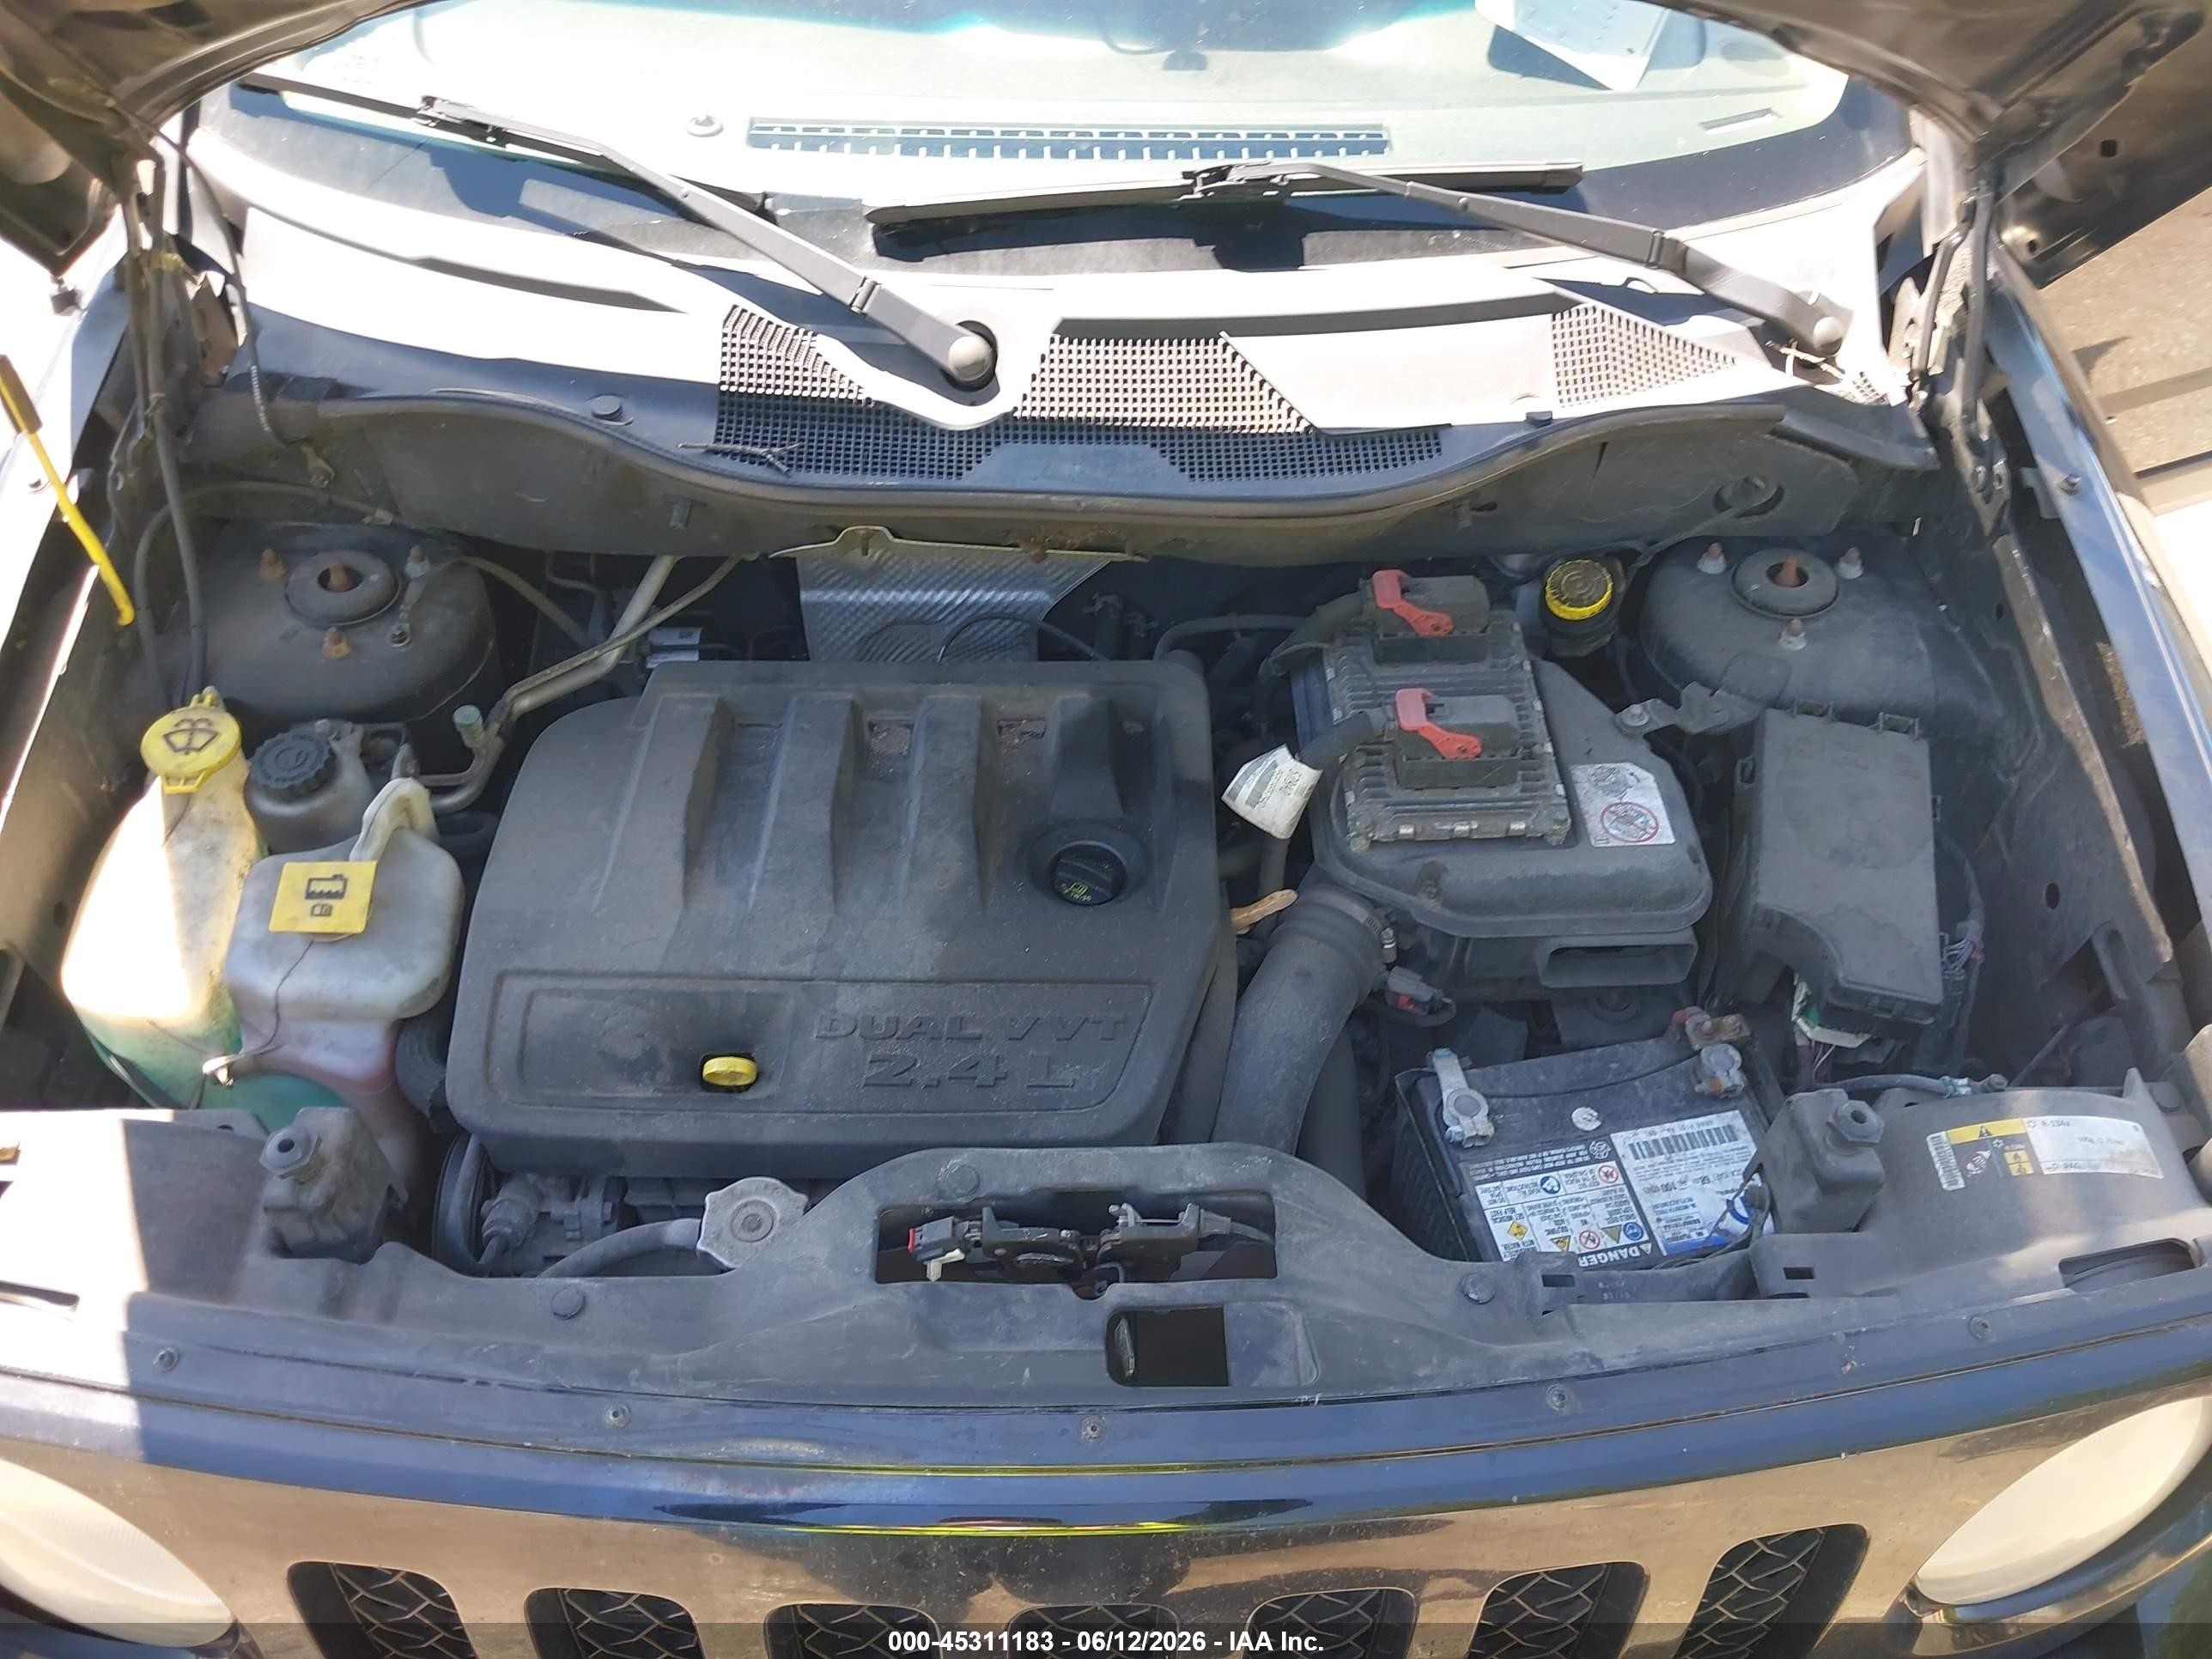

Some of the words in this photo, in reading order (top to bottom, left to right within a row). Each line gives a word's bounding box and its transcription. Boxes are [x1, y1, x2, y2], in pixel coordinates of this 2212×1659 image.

[815, 1013, 983, 1041] DUAL
[1007, 1013, 1127, 1041] VVT
[860, 1053, 1007, 1088] 2.4
[1578, 1248, 1639, 1266] DANGER
